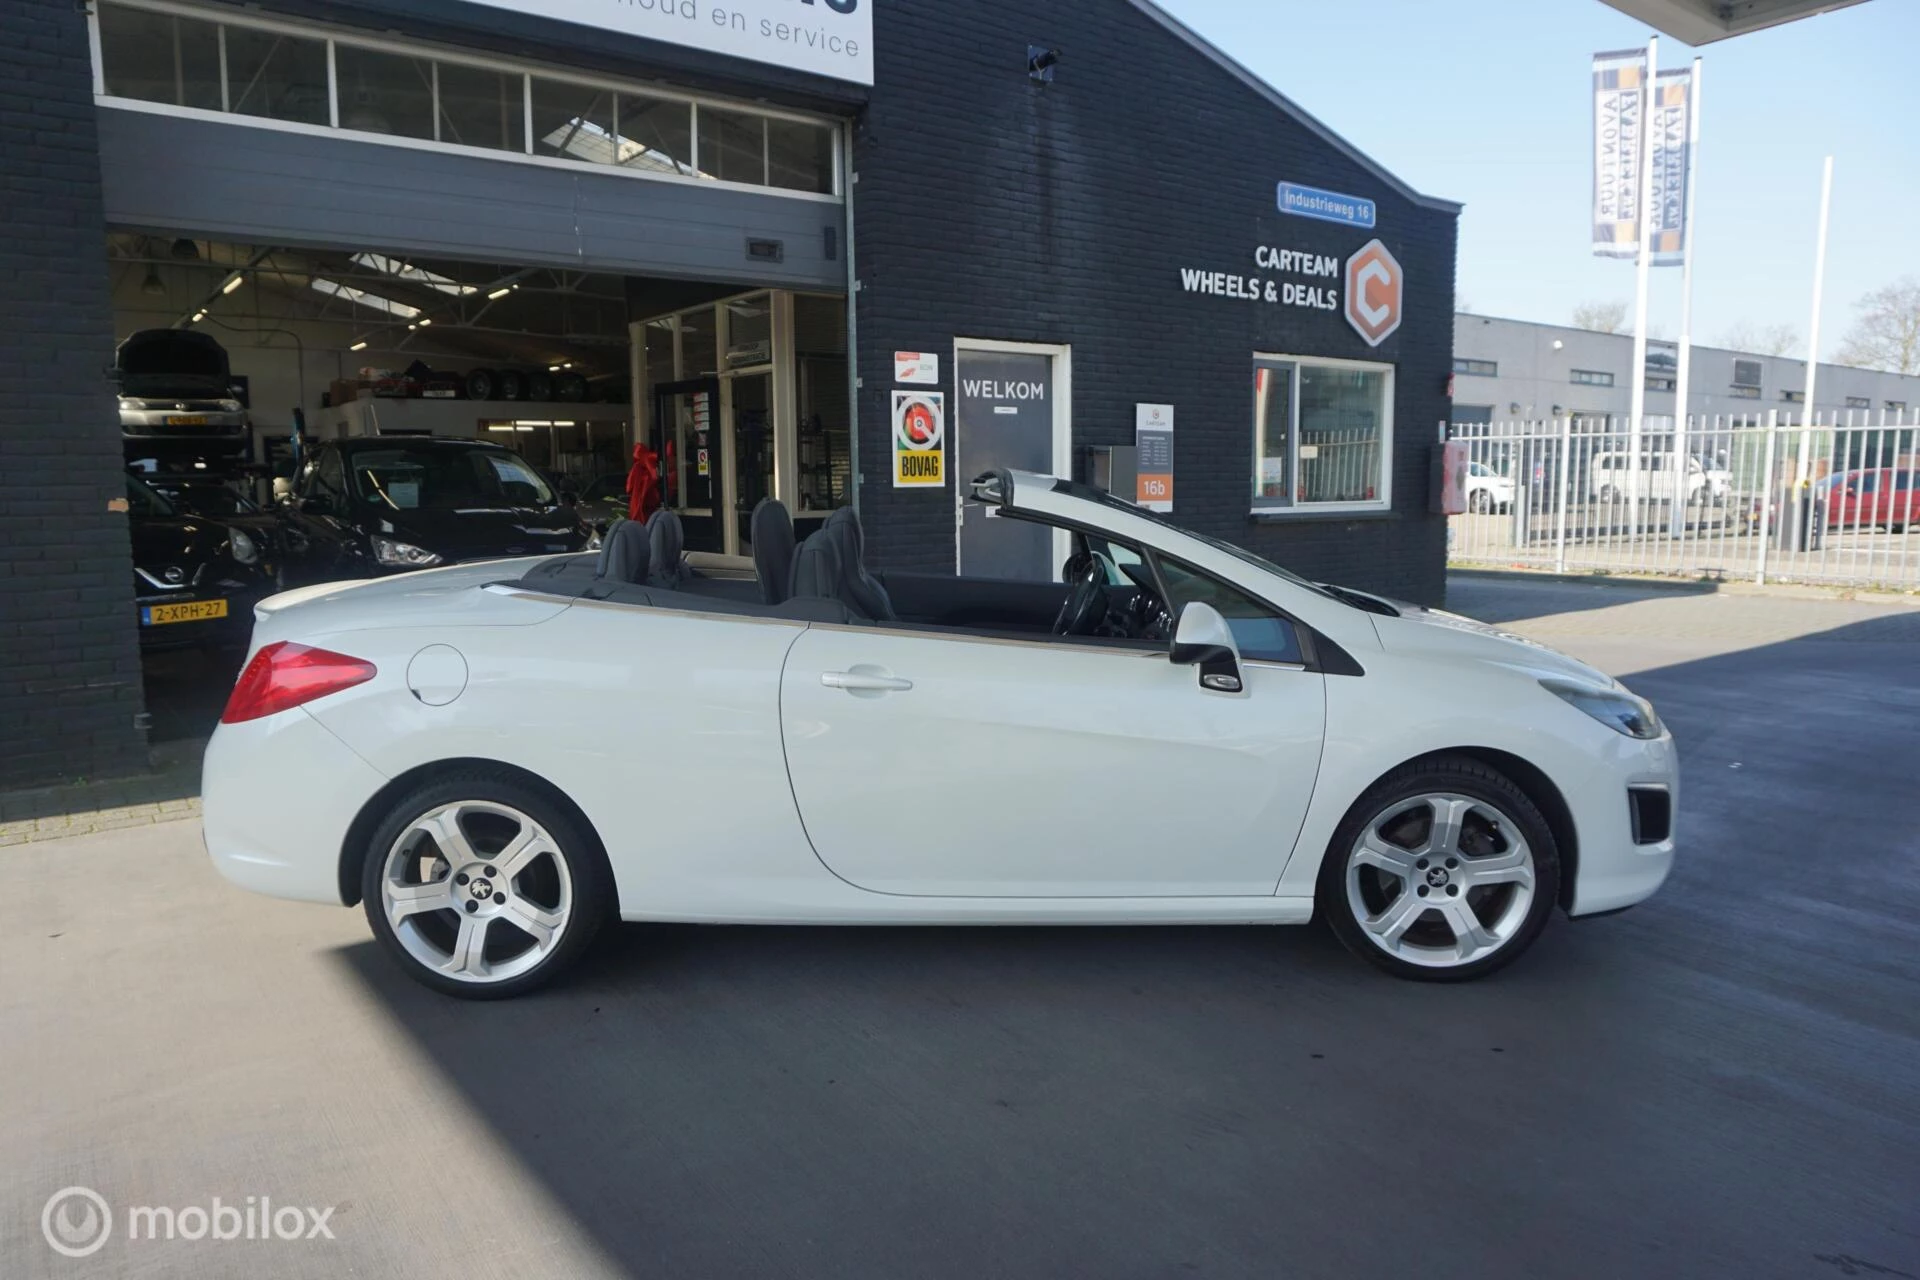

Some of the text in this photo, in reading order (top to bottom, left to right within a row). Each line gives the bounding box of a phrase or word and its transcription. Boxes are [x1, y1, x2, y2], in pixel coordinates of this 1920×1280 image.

[711, 8, 746, 31] en
[760, 19, 859, 57] service
[1285, 190, 1369, 219] Industrieweg 16
[1255, 246, 1338, 278] CARTEAM
[1181, 268, 1337, 311] WHEELS & DEALS
[963, 379, 1044, 400] WELKOM
[901, 455, 939, 477] BOVAG
[1143, 480, 1166, 497] 16b
[155, 602, 221, 622] 2-XPH-27
